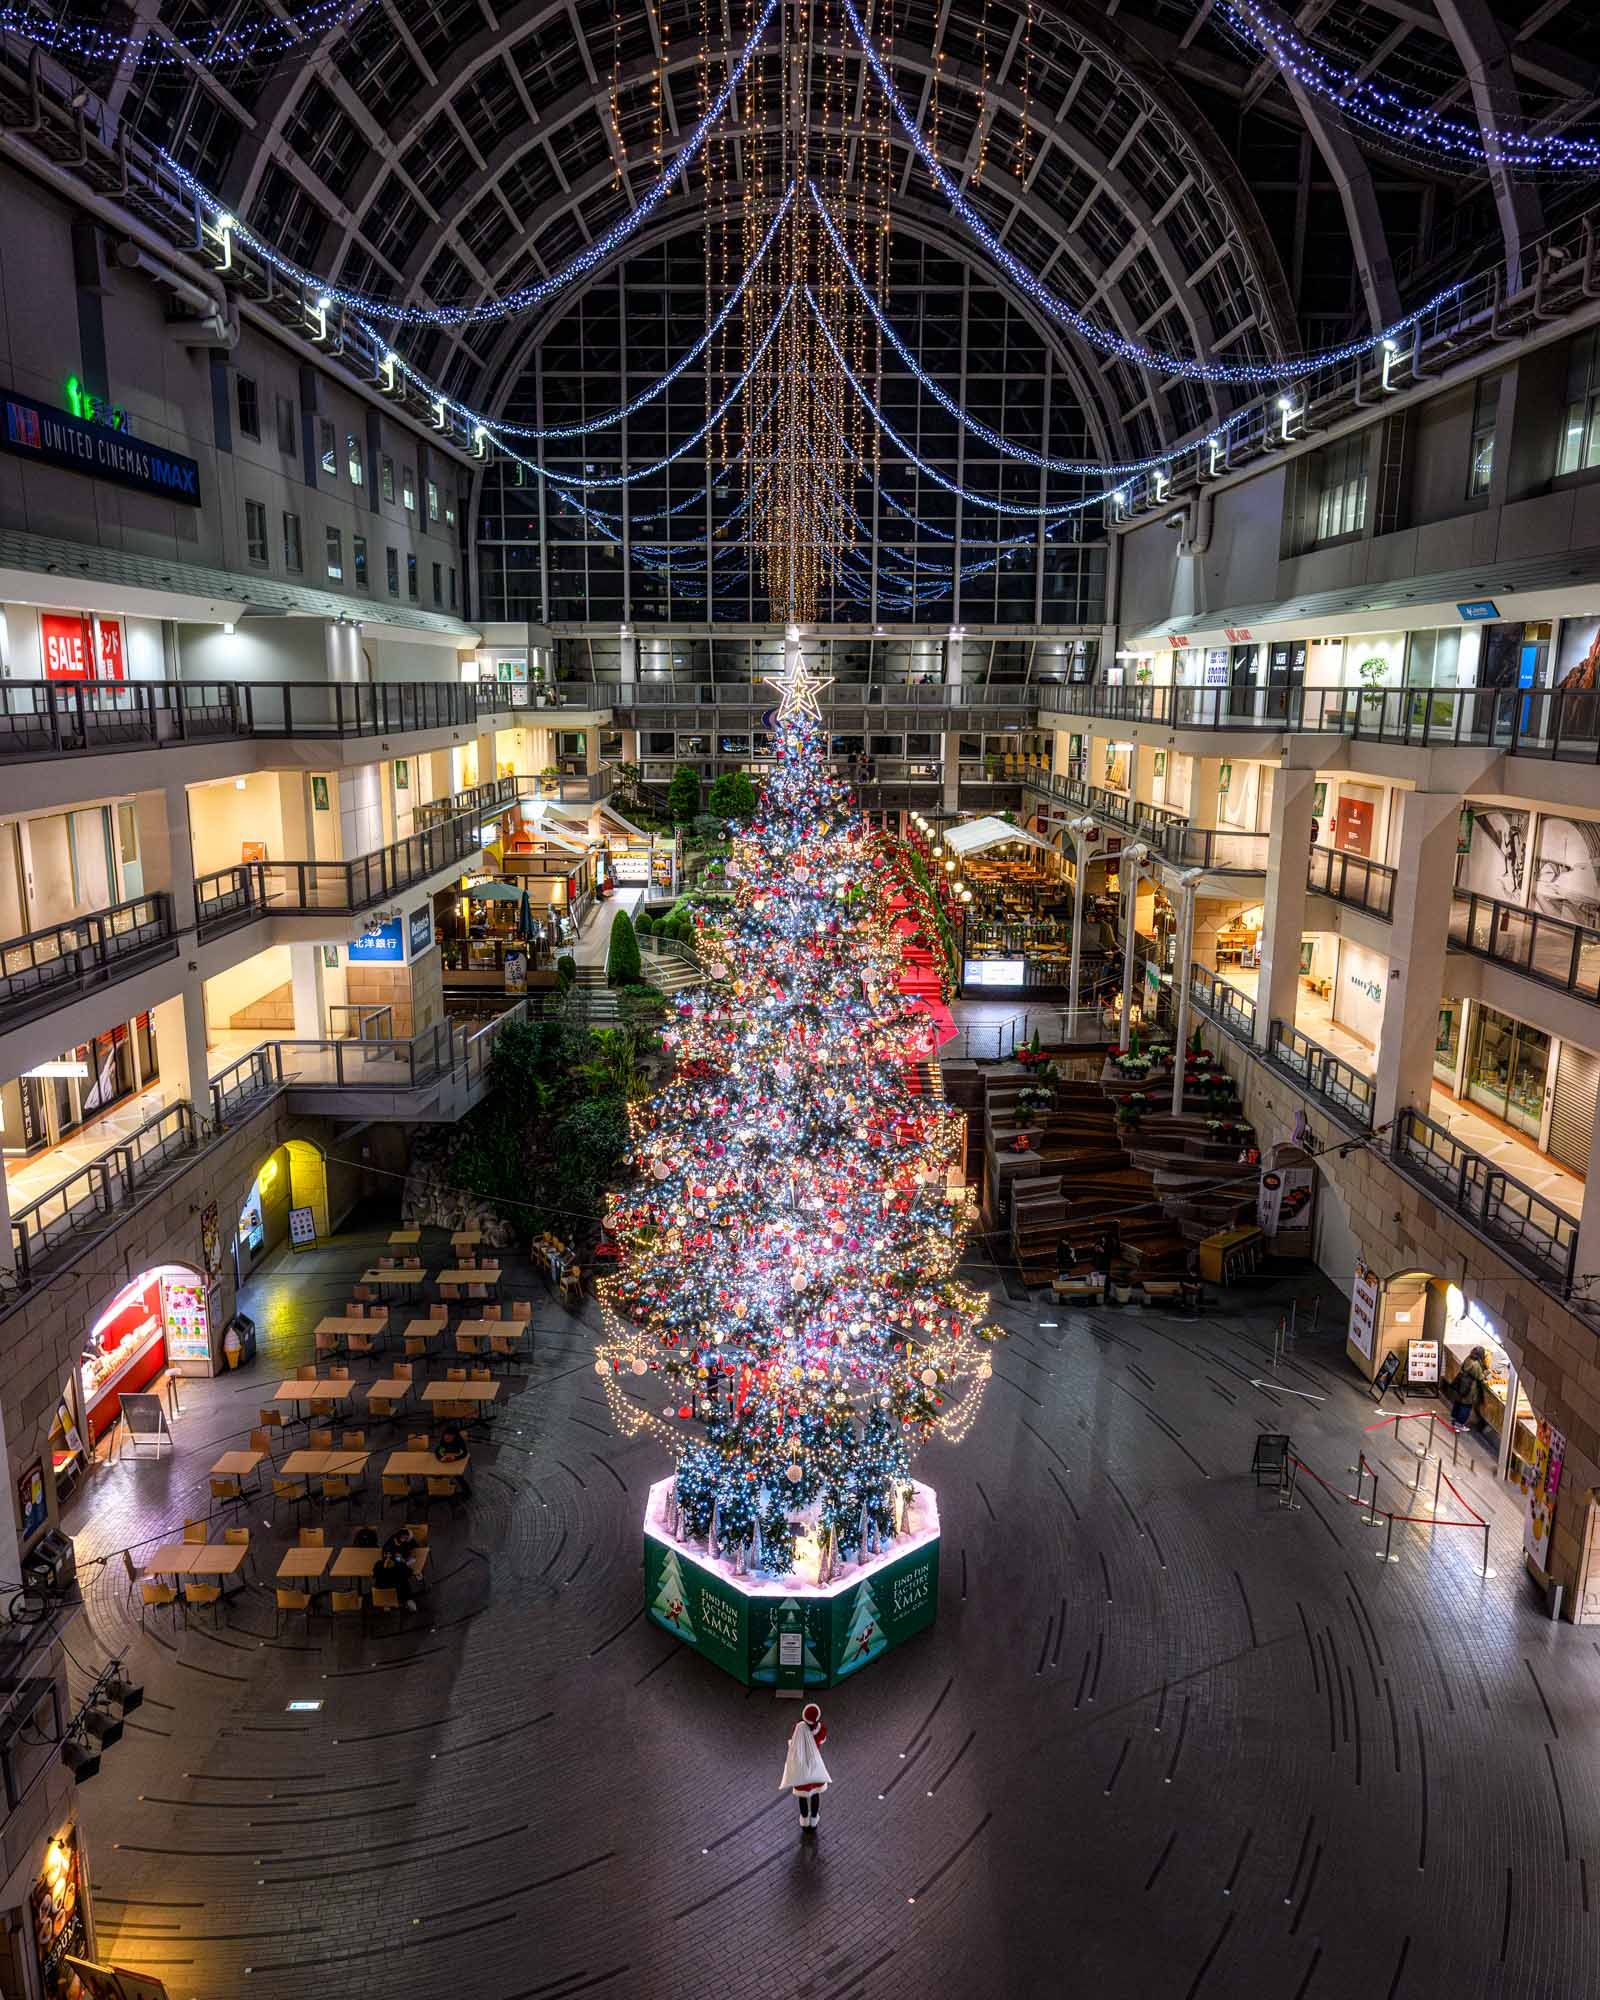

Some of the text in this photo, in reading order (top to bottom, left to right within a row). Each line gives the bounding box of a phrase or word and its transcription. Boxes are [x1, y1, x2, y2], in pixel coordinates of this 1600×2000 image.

[43, 420, 195, 494] UNITED CINEMAS IMAX
[48, 635, 84, 671] SALE
[354, 938, 397, 948] 北洋銀行
[894, 1562, 929, 1590] FIND FUN
[894, 1572, 929, 1600] FACTORY
[701, 1587, 738, 1618] FIND FUN
[701, 1597, 738, 1627] FACTORY
[894, 1582, 929, 1613] XMAS
[702, 1607, 738, 1641] XMAS
